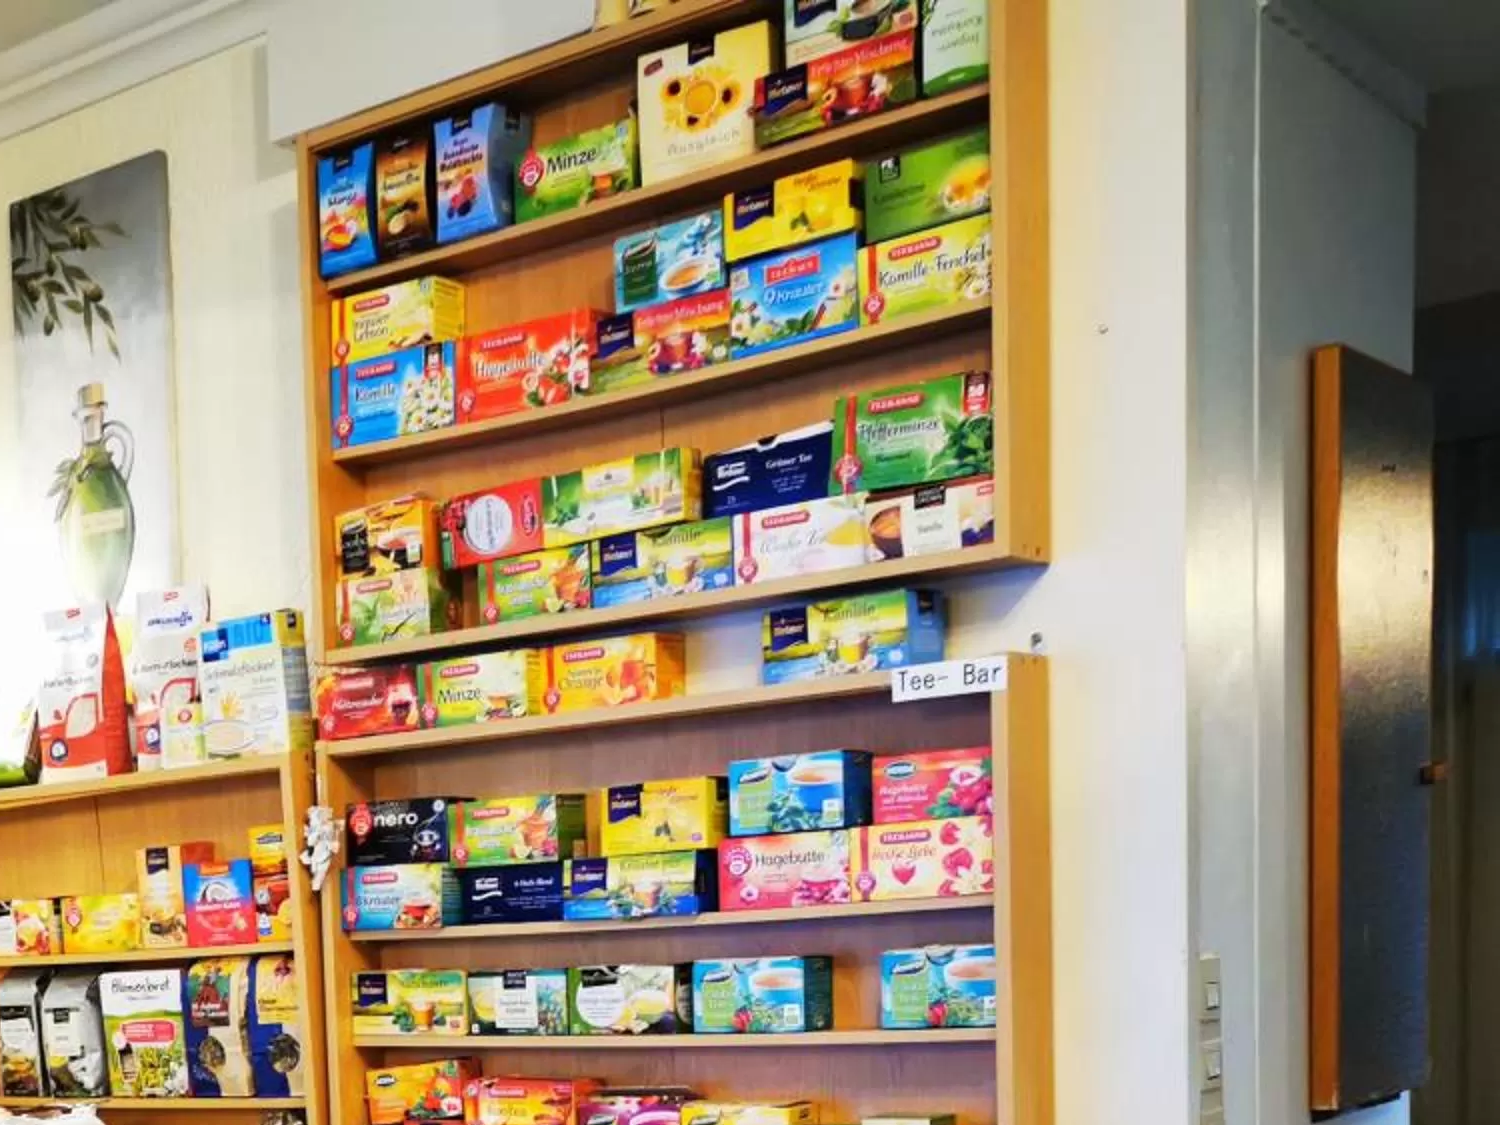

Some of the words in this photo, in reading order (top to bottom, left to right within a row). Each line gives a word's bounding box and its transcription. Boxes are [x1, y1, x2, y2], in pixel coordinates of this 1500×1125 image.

[547, 148, 596, 174] Minze
[879, 260, 928, 288] Kamille
[897, 670, 949, 693] Tee-
[963, 663, 1002, 687] Bar
[438, 686, 481, 704] Minze
[373, 810, 419, 828] nero
[755, 850, 825, 869] Hagebutte
